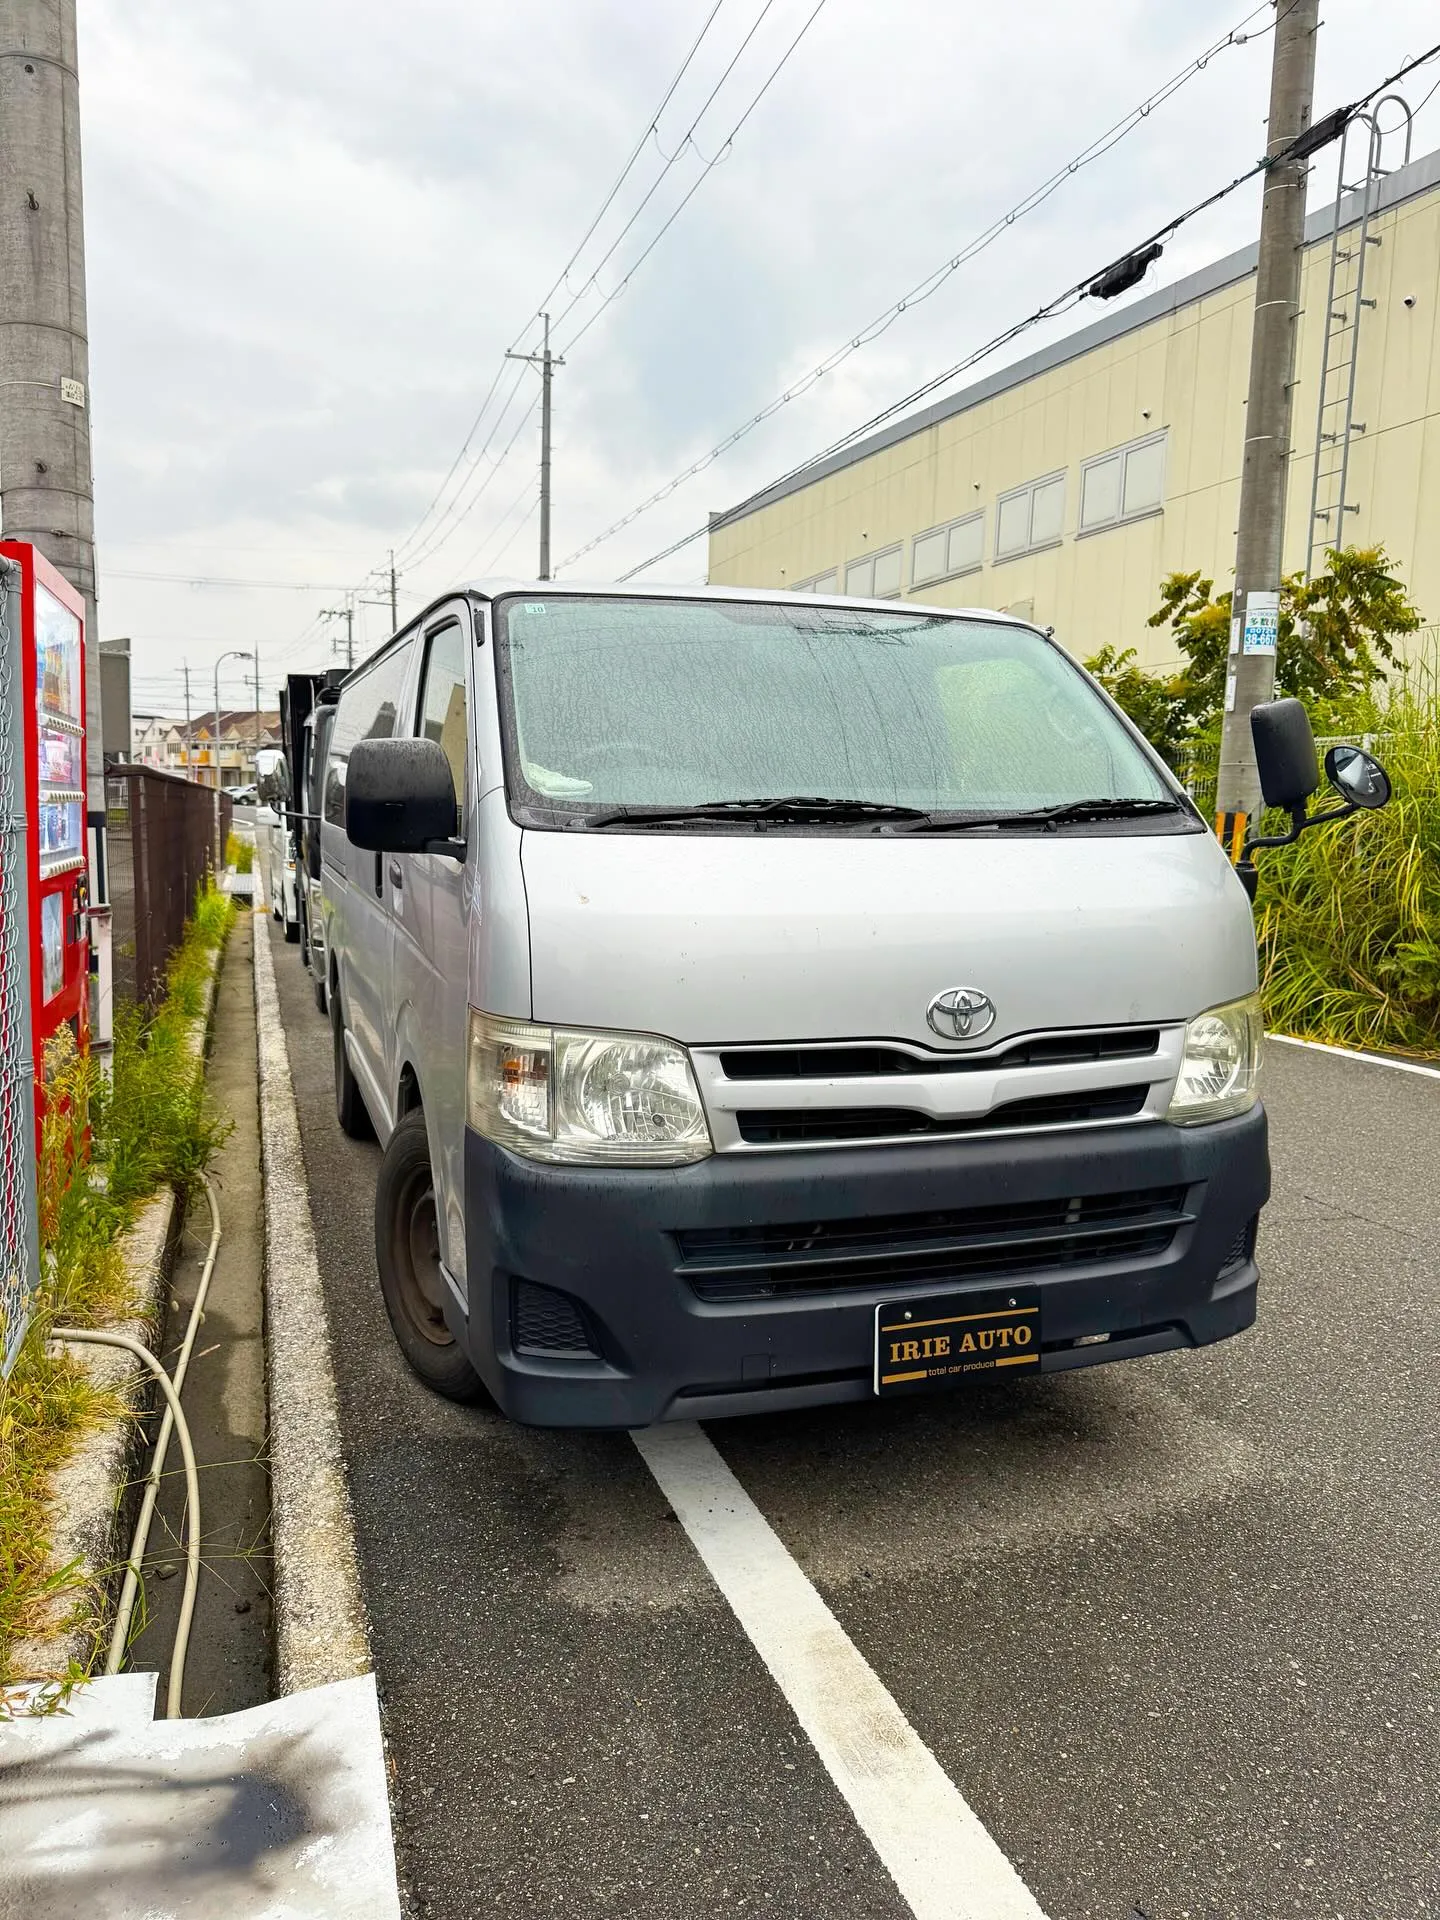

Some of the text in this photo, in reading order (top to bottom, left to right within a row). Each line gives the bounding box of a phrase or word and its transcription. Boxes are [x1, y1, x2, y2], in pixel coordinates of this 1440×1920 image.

[890, 1325, 1032, 1363] IRIE AUTO
[928, 1366, 947, 1377] total
[948, 1364, 961, 1374] car
